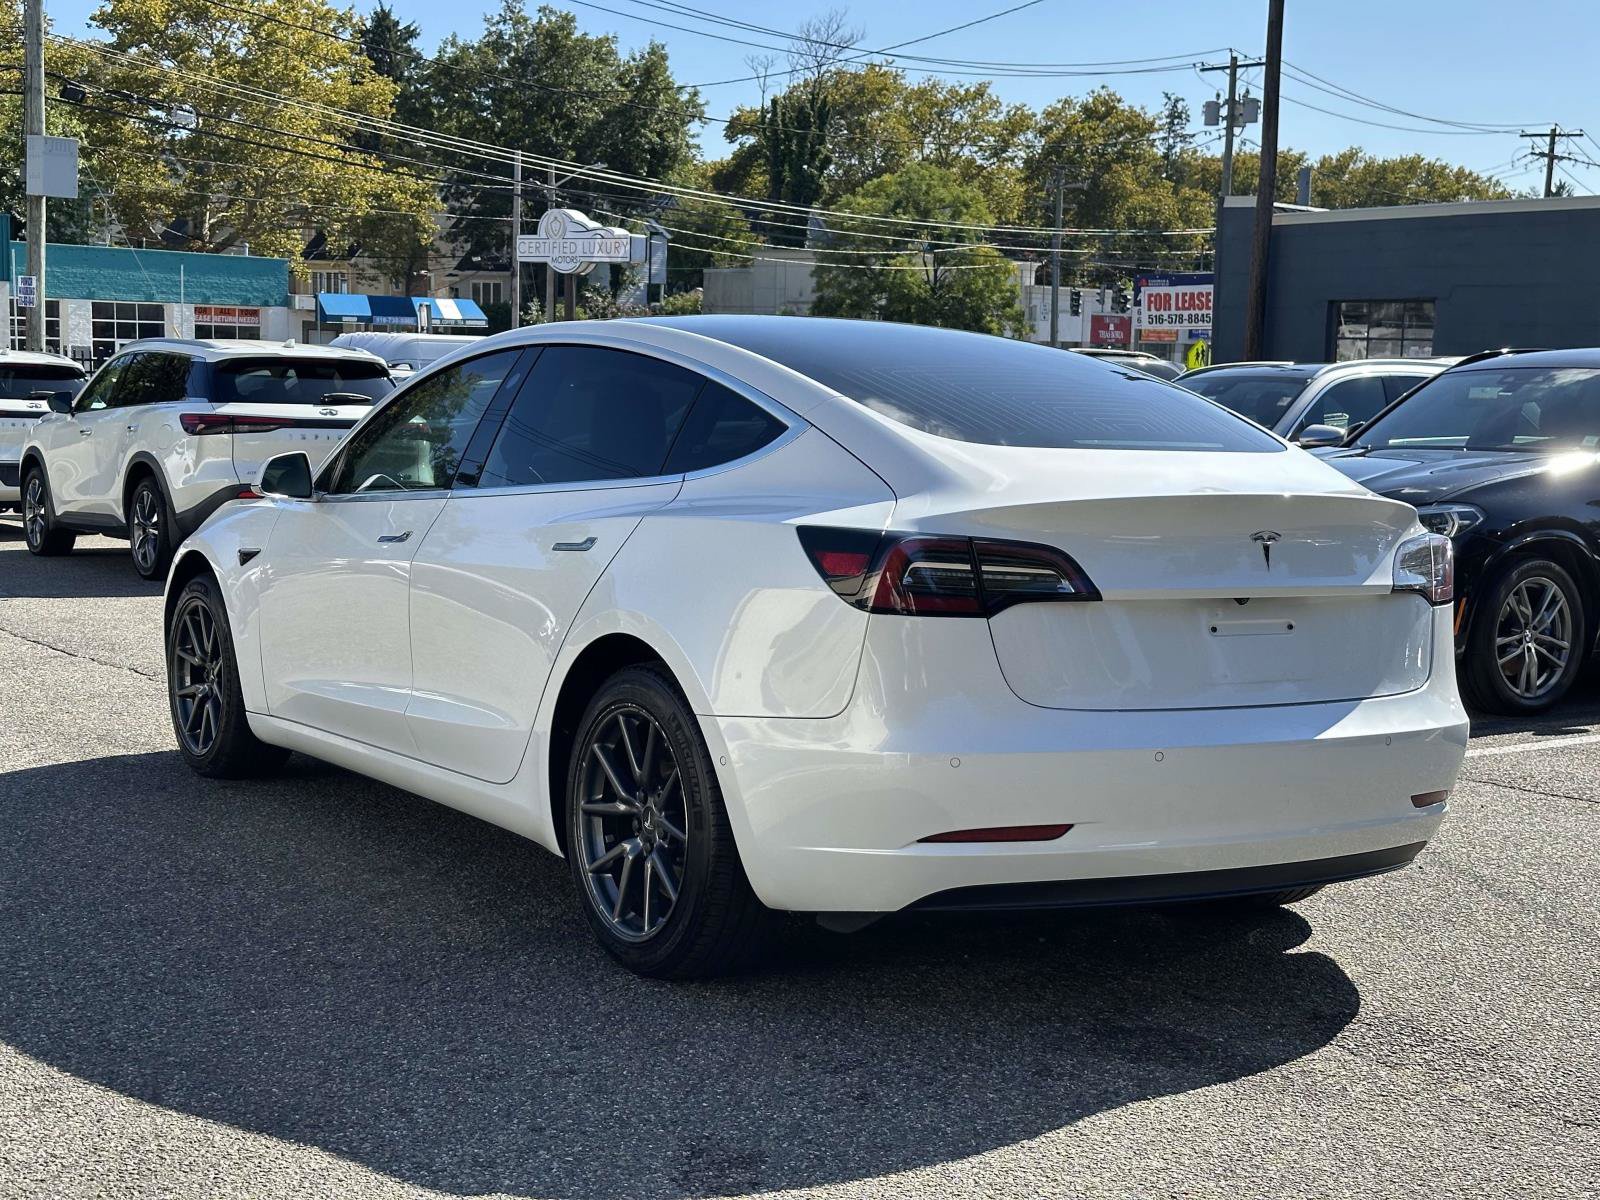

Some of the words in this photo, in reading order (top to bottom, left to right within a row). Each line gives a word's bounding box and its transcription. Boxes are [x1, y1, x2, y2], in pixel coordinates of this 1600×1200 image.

[518, 241, 577, 255] CERTIFIED
[582, 240, 629, 255] LUXURY
[551, 256, 579, 264] MOTORS
[1147, 292, 1172, 312] FOR
[1174, 291, 1212, 311] LEASE
[219, 307, 230, 315] ALL
[239, 316, 259, 324] NEEDS
[1148, 313, 1212, 325] 516-578-8845
